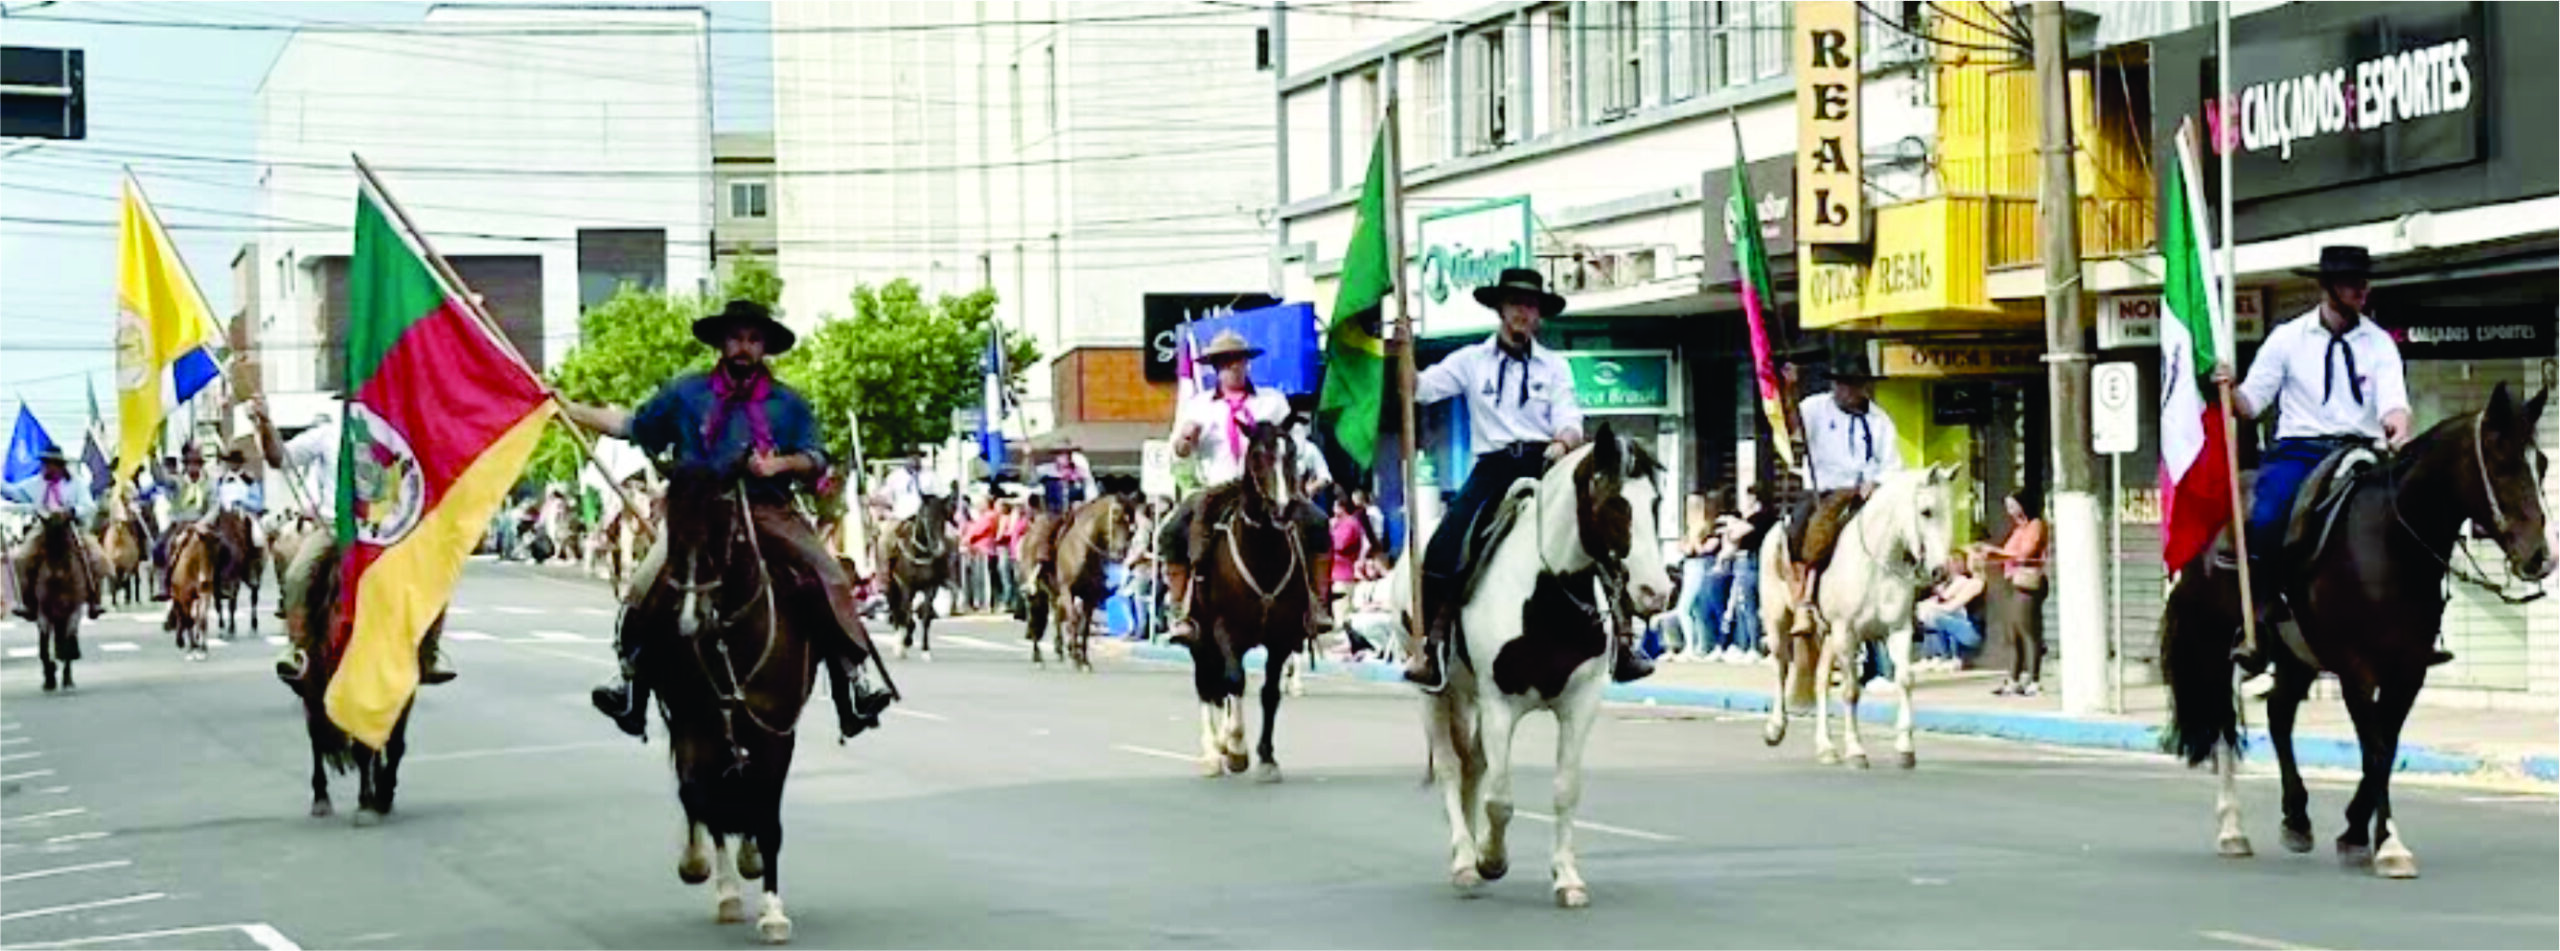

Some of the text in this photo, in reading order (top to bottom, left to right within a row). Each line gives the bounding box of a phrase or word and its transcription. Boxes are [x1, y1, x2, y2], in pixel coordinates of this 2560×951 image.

[1811, 29, 1850, 226] REAL
[2240, 67, 2345, 160] CALÇADOS
[2356, 38, 2471, 129] ESPORTES
[1878, 250, 1931, 294] REAL
[2476, 324, 2535, 342] ESPORTES
